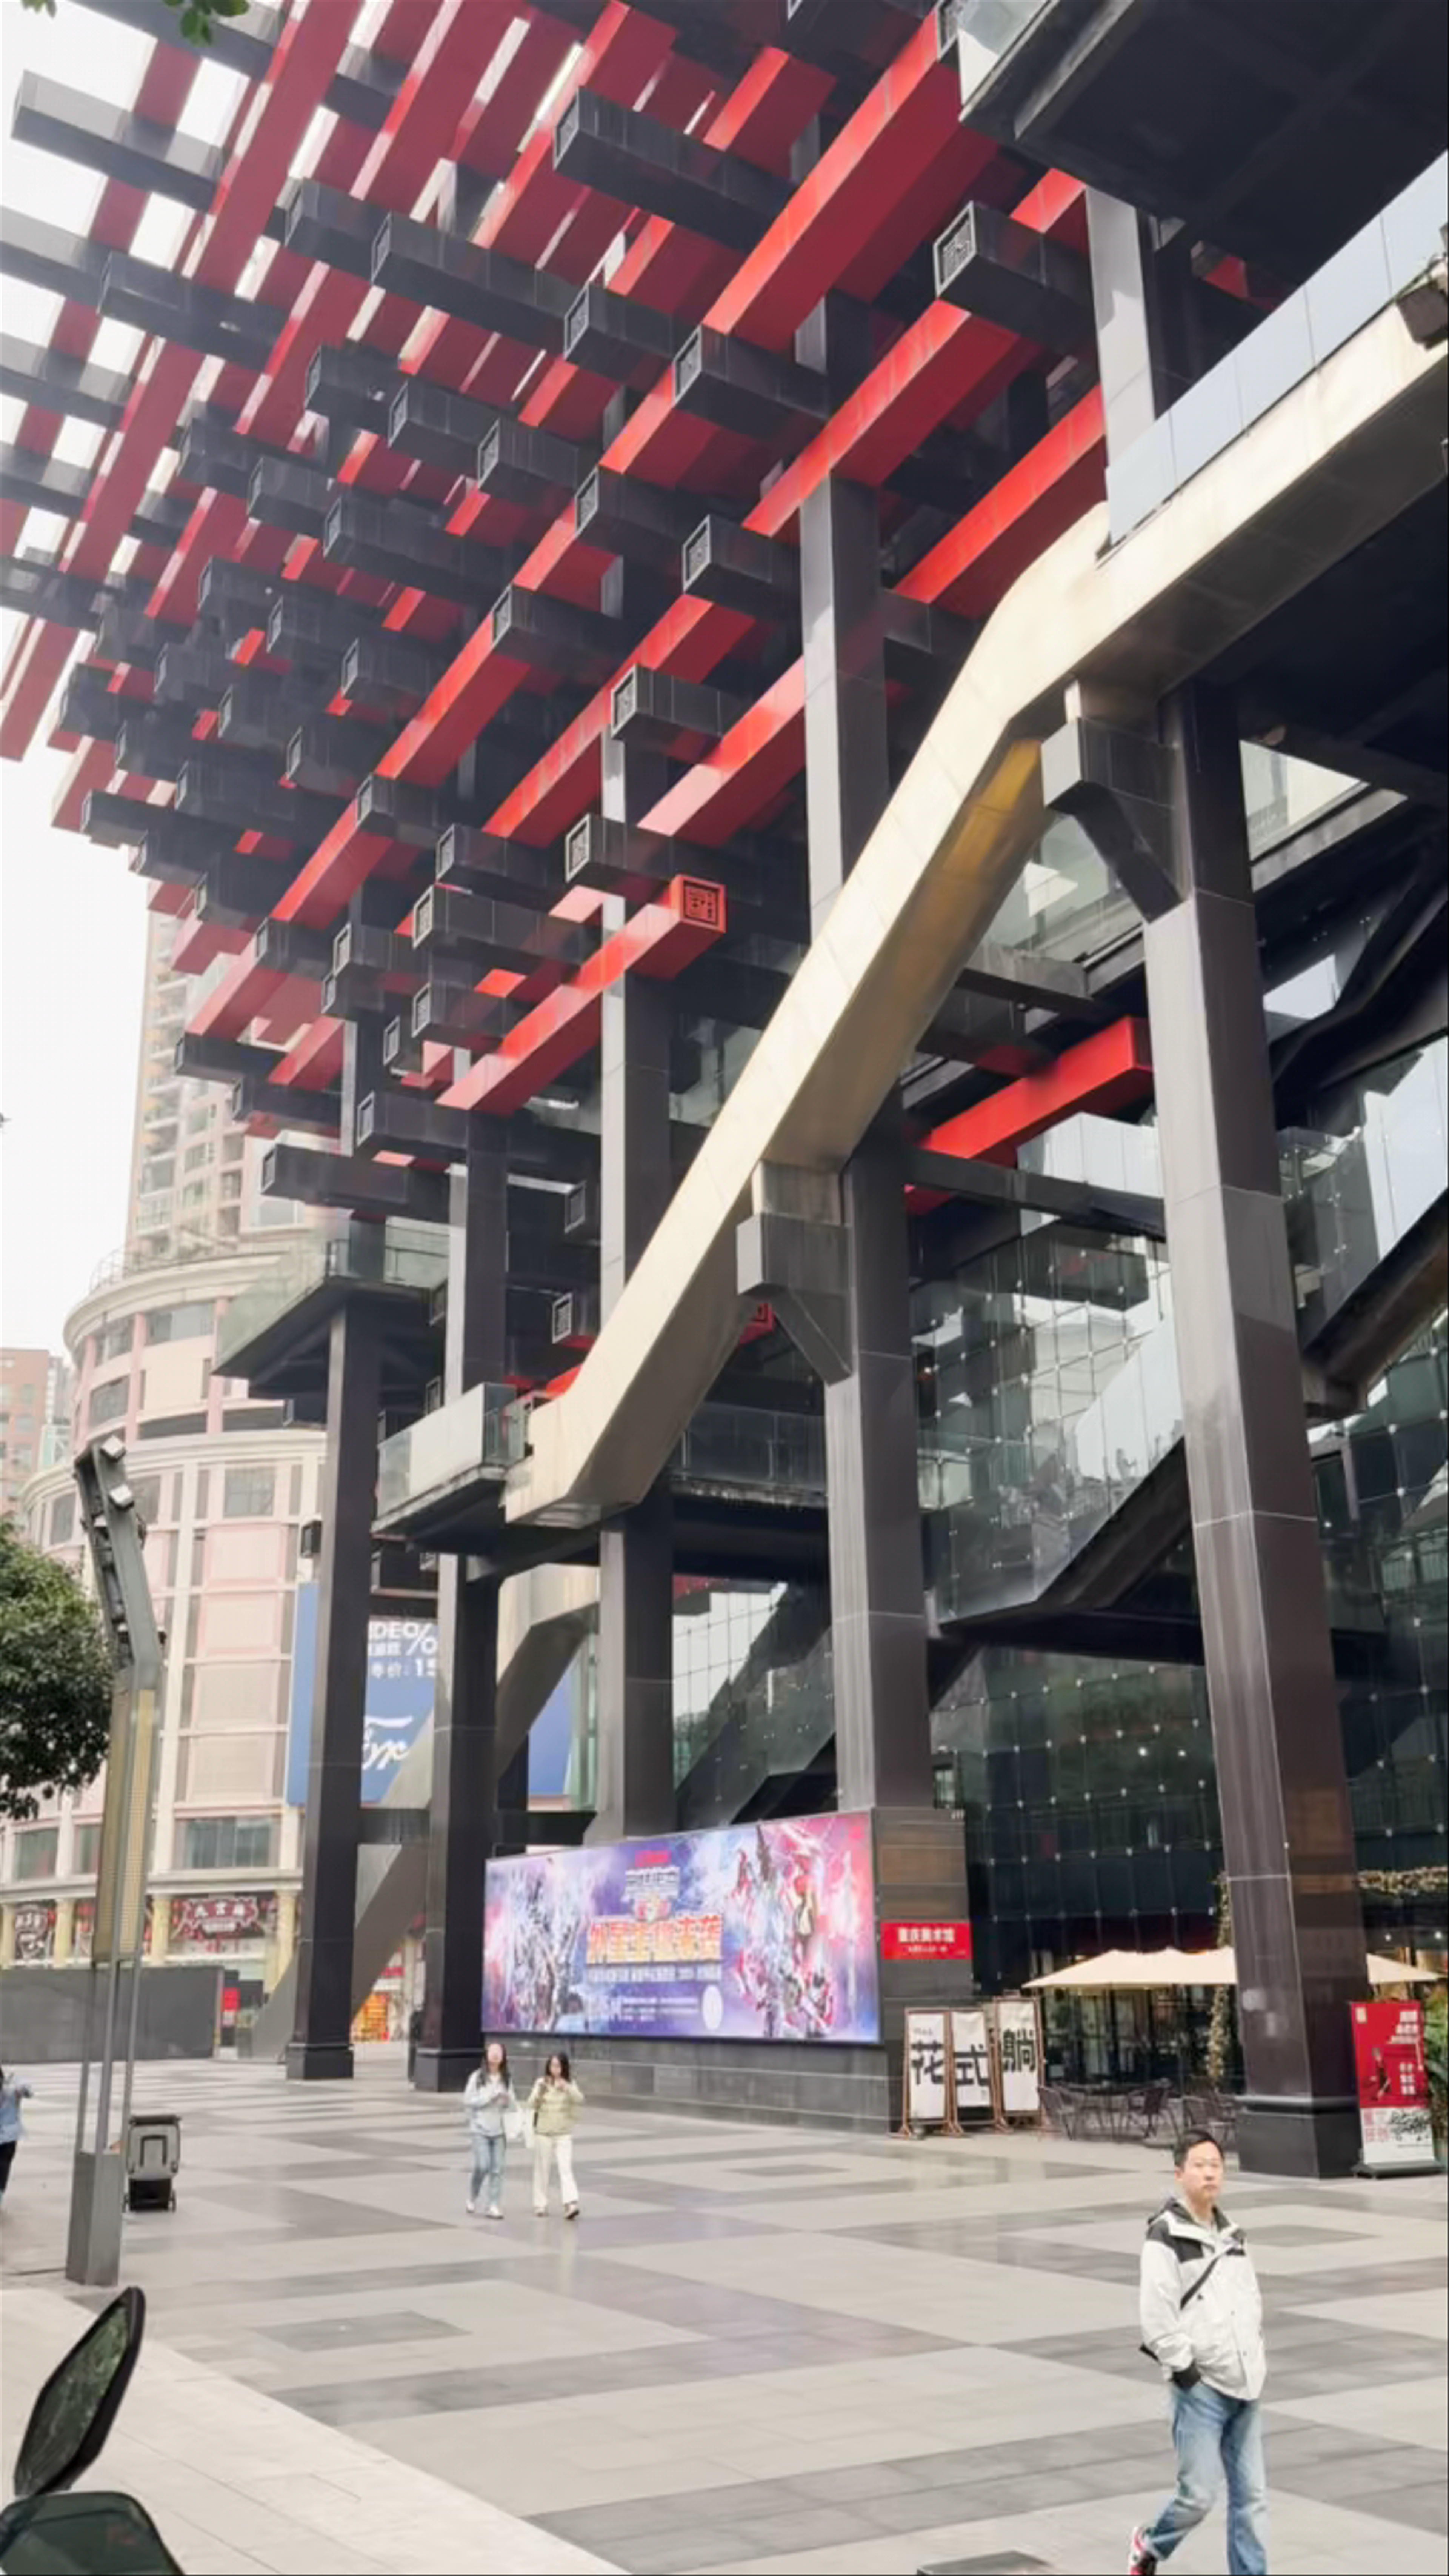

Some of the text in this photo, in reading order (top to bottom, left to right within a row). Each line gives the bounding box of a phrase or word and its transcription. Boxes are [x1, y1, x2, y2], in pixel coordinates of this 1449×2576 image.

[911, 2027, 1036, 2086] 花 式 躺
